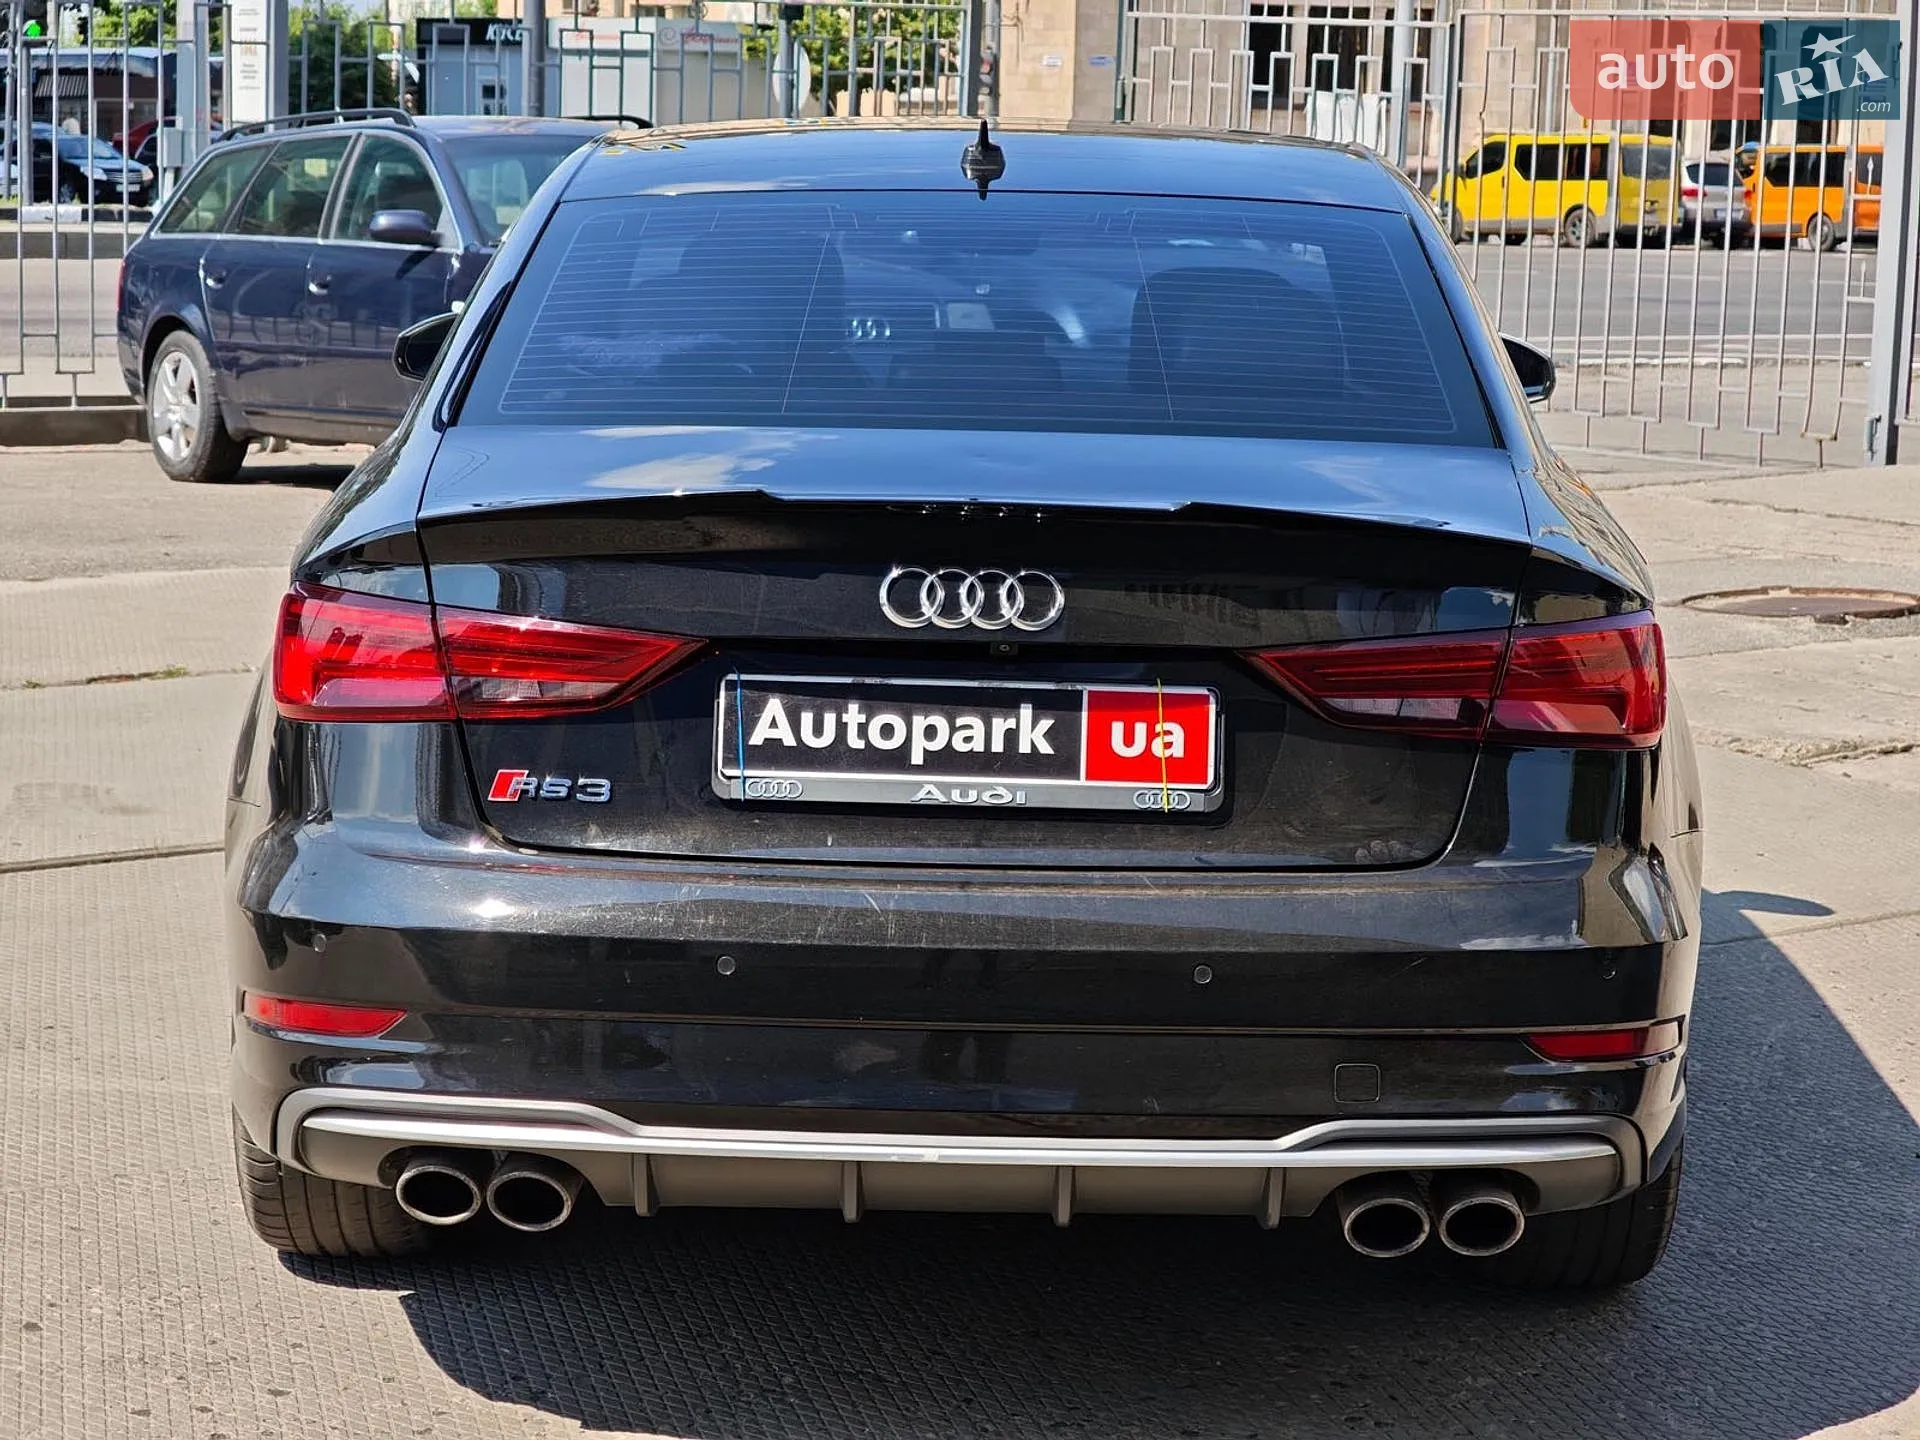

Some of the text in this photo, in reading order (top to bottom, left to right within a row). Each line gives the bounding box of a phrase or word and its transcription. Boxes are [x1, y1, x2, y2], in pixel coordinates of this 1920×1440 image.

[748, 698, 1186, 766] Autopark ua
[910, 783, 1028, 806] Audi
